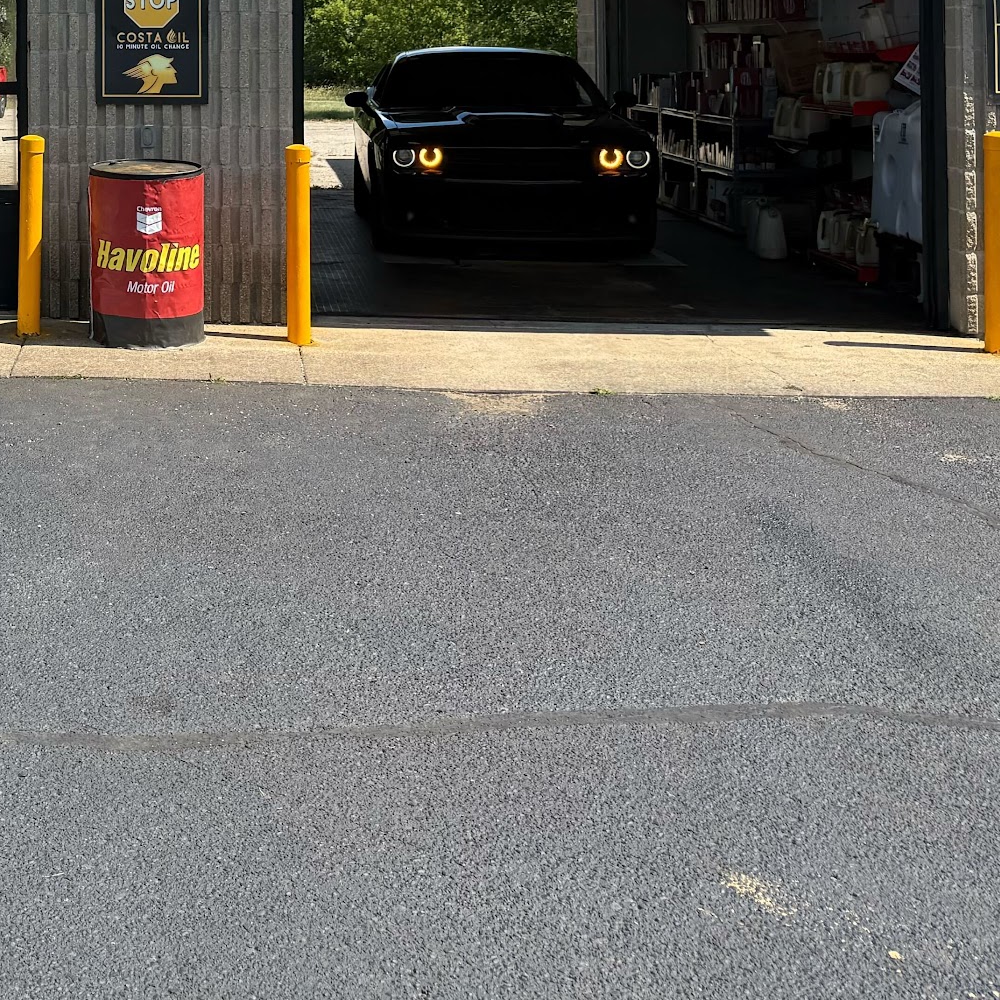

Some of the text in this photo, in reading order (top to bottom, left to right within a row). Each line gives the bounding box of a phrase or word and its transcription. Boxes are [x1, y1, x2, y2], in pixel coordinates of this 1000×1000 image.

[116, 31, 162, 43] COSTA
[96, 239, 200, 274] Havoline
[127, 281, 176, 294] Motor Oil
